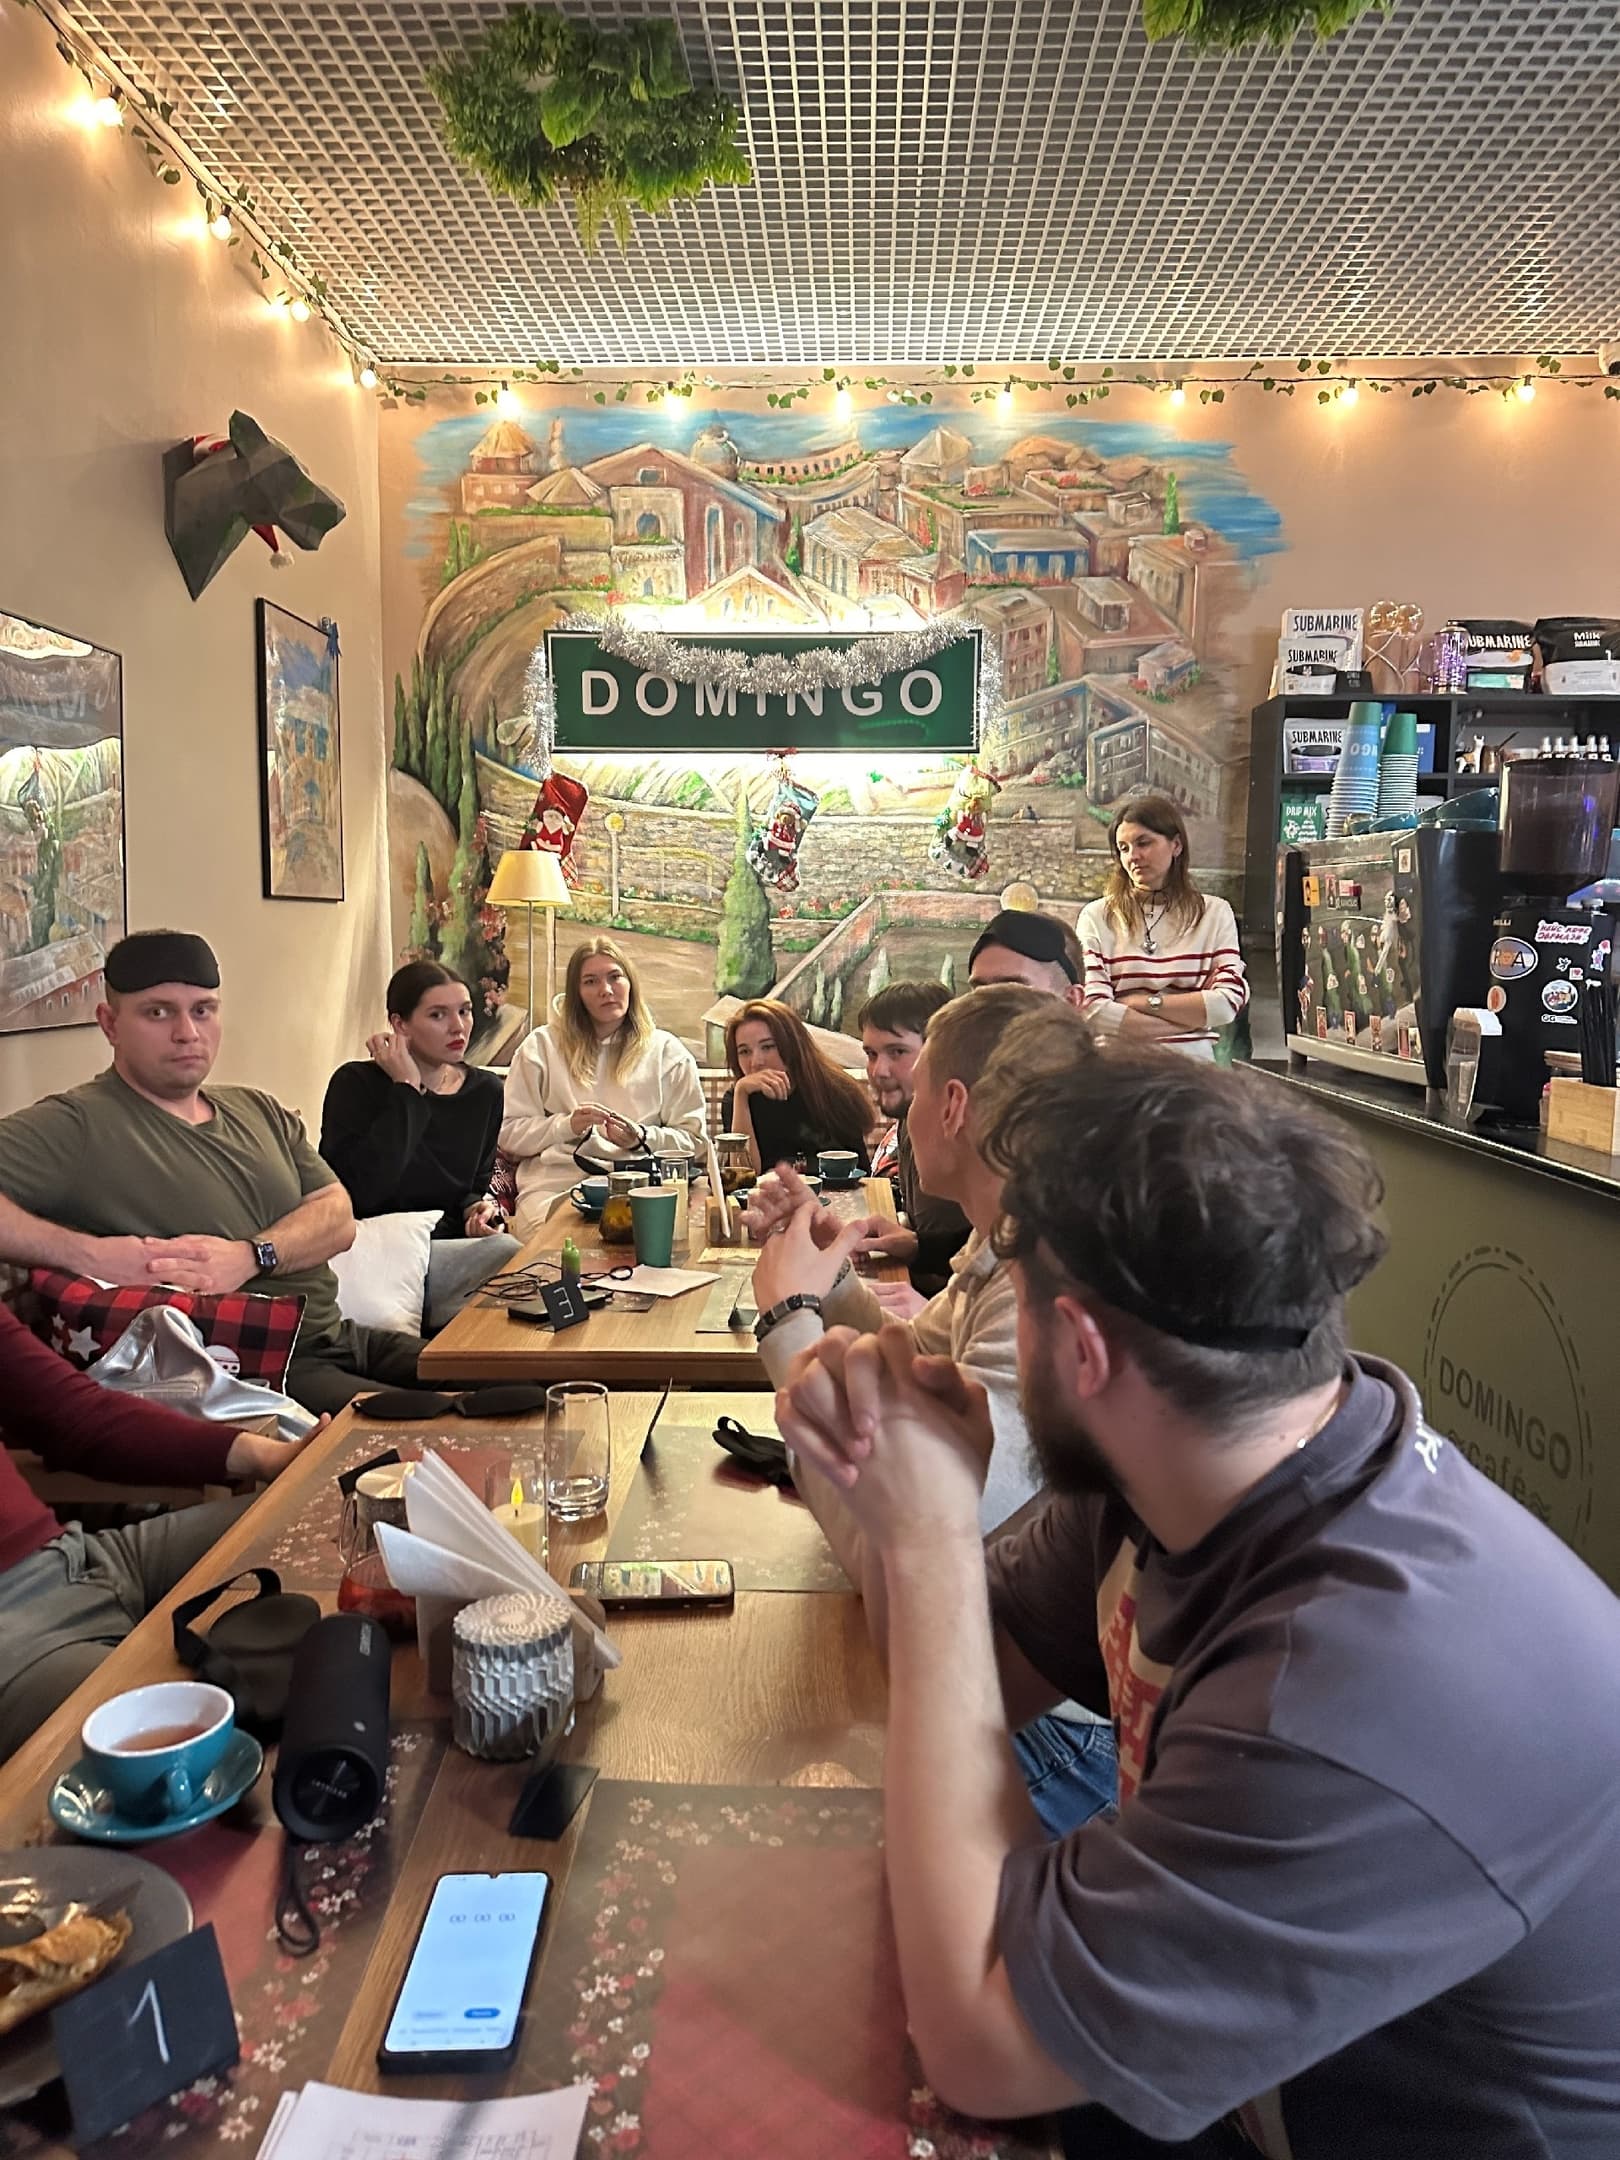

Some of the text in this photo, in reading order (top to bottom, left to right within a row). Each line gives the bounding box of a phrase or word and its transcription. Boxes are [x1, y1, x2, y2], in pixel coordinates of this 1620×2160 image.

[1293, 615, 1358, 631] SUBMARINE
[1465, 634, 1532, 649] UBMARINE
[1573, 632, 1601, 641] Milk
[1288, 650, 1338, 663] SUBMARINE
[581, 670, 943, 717] DOMINGO
[1292, 729, 1342, 744] SUBMARINE
[1286, 806, 1318, 817] DRIP MIX
[1439, 1355, 1572, 1479] DOMINGO
[127, 1979, 170, 2064] 1
